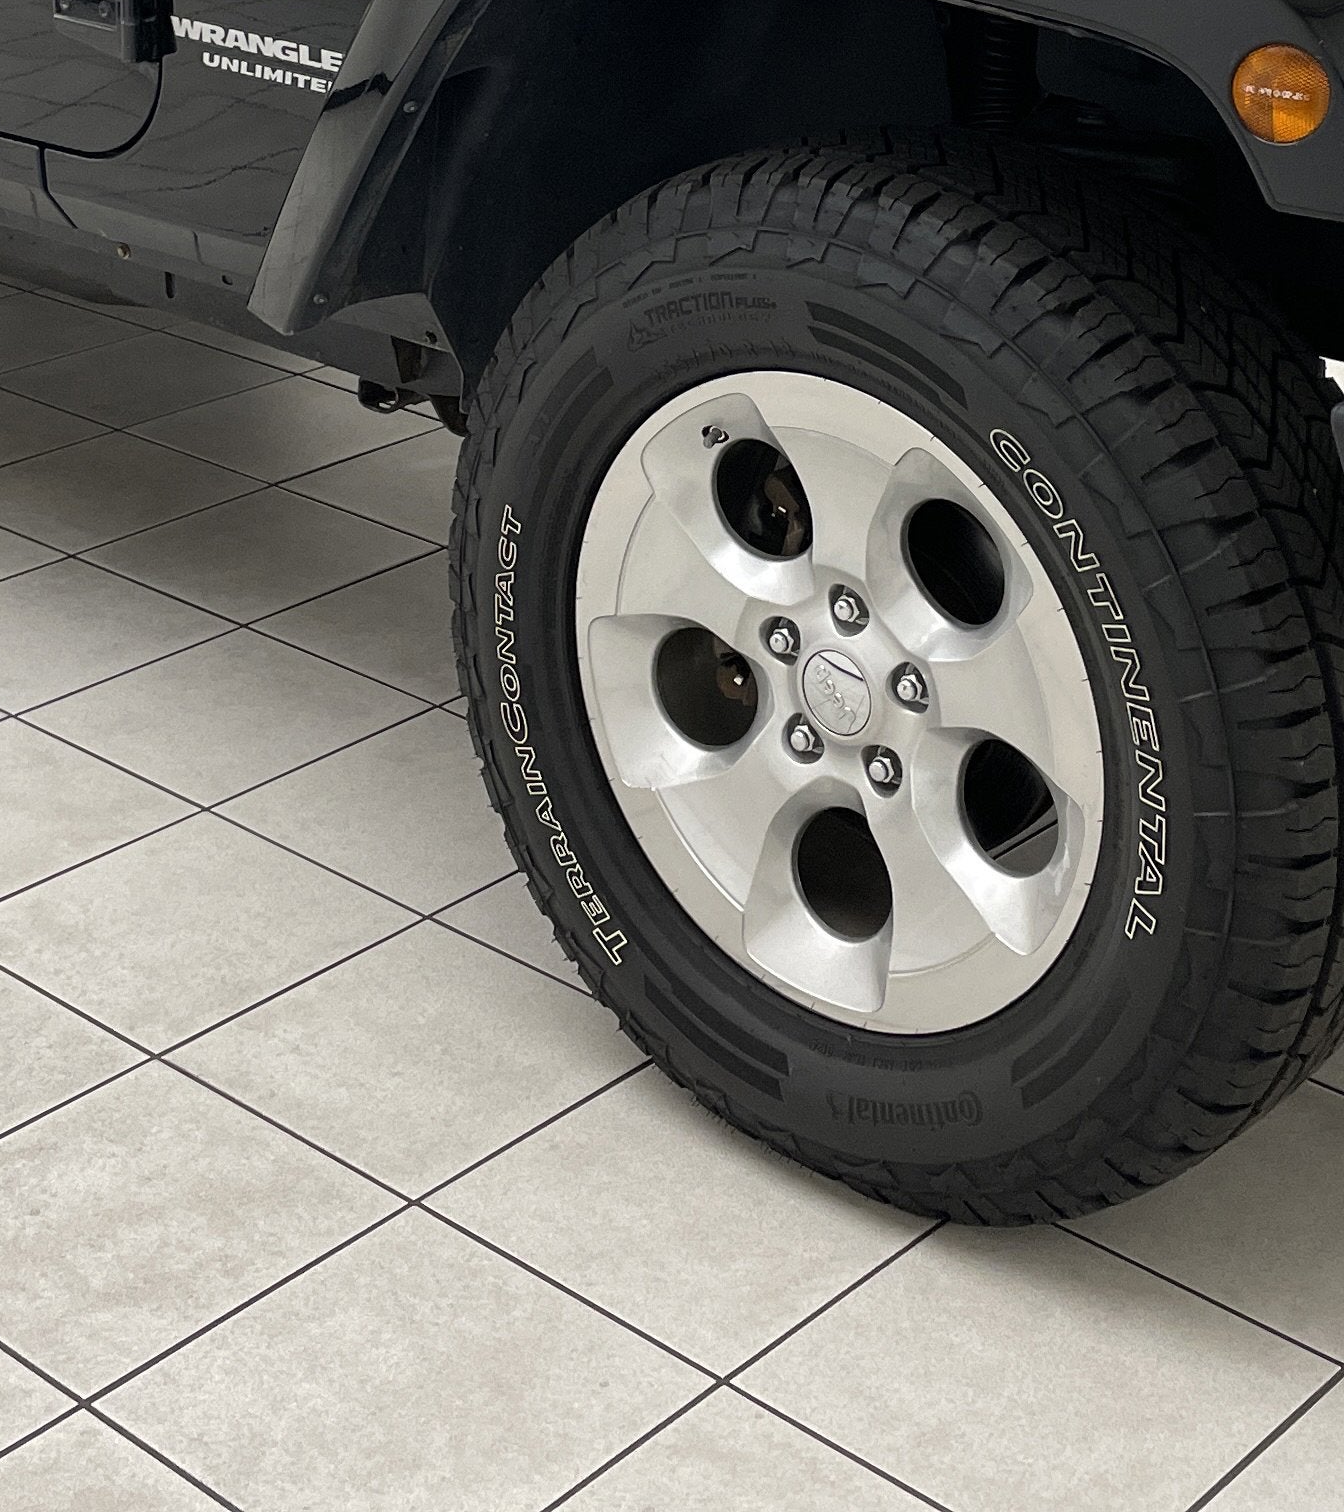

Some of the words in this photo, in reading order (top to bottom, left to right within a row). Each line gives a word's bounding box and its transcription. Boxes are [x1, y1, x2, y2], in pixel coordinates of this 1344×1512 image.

[170, 15, 343, 72] WRANGLE
[202, 52, 332, 94] UNLIMITE
[988, 427, 1166, 940] CONTINENTAL
[494, 504, 628, 966] TERRAINCONTACT
[848, 1090, 984, 1130] Continental
